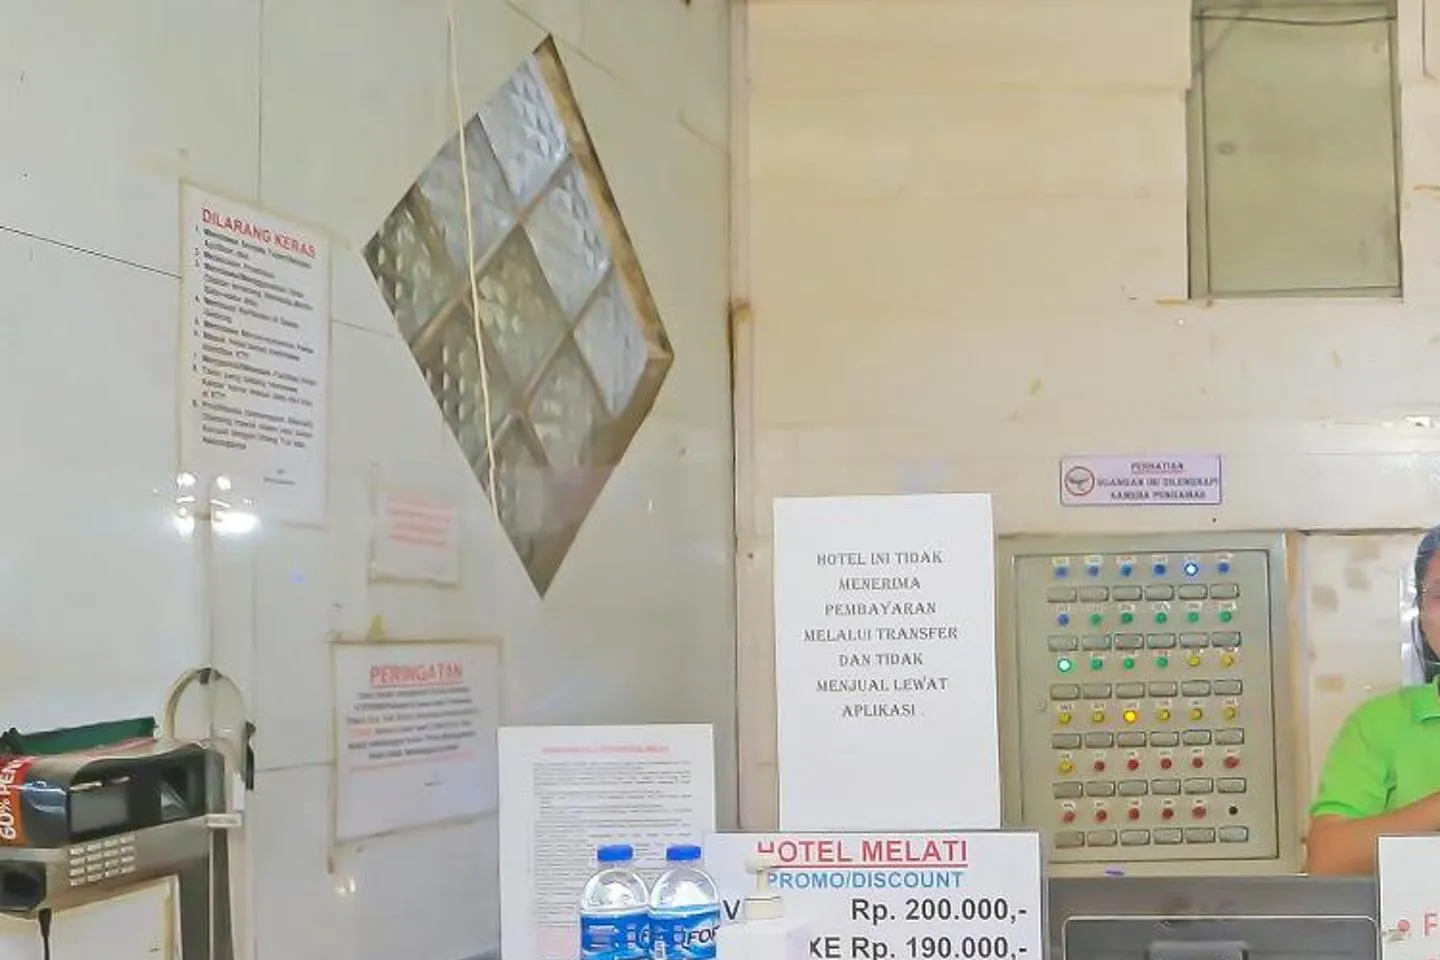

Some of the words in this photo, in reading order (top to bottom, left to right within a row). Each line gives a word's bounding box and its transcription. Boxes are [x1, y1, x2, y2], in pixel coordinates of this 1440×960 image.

[202, 208, 271, 244] DILARANG
[273, 232, 316, 259] KERAS
[816, 551, 866, 566] HOTEL
[870, 551, 890, 565] INI
[895, 550, 943, 565] TIDAK
[838, 577, 921, 591] MENERIMA
[824, 601, 937, 616] PEMBAYARAN
[803, 628, 871, 642] MELALUI
[875, 626, 958, 641] TRANSFER
[838, 653, 871, 667] DAN
[875, 652, 924, 667] TIDAK
[369, 663, 464, 684] PERINGATAN
[816, 678, 889, 693] MENJUAL
[893, 676, 949, 691] LEWAT
[842, 703, 915, 718] APLIKASI
[862, 840, 967, 862] MELATI
[768, 871, 964, 889] PROMO/DISCOUNT
[851, 898, 896, 926] Rp.
[905, 898, 1027, 925] 200.000,-
